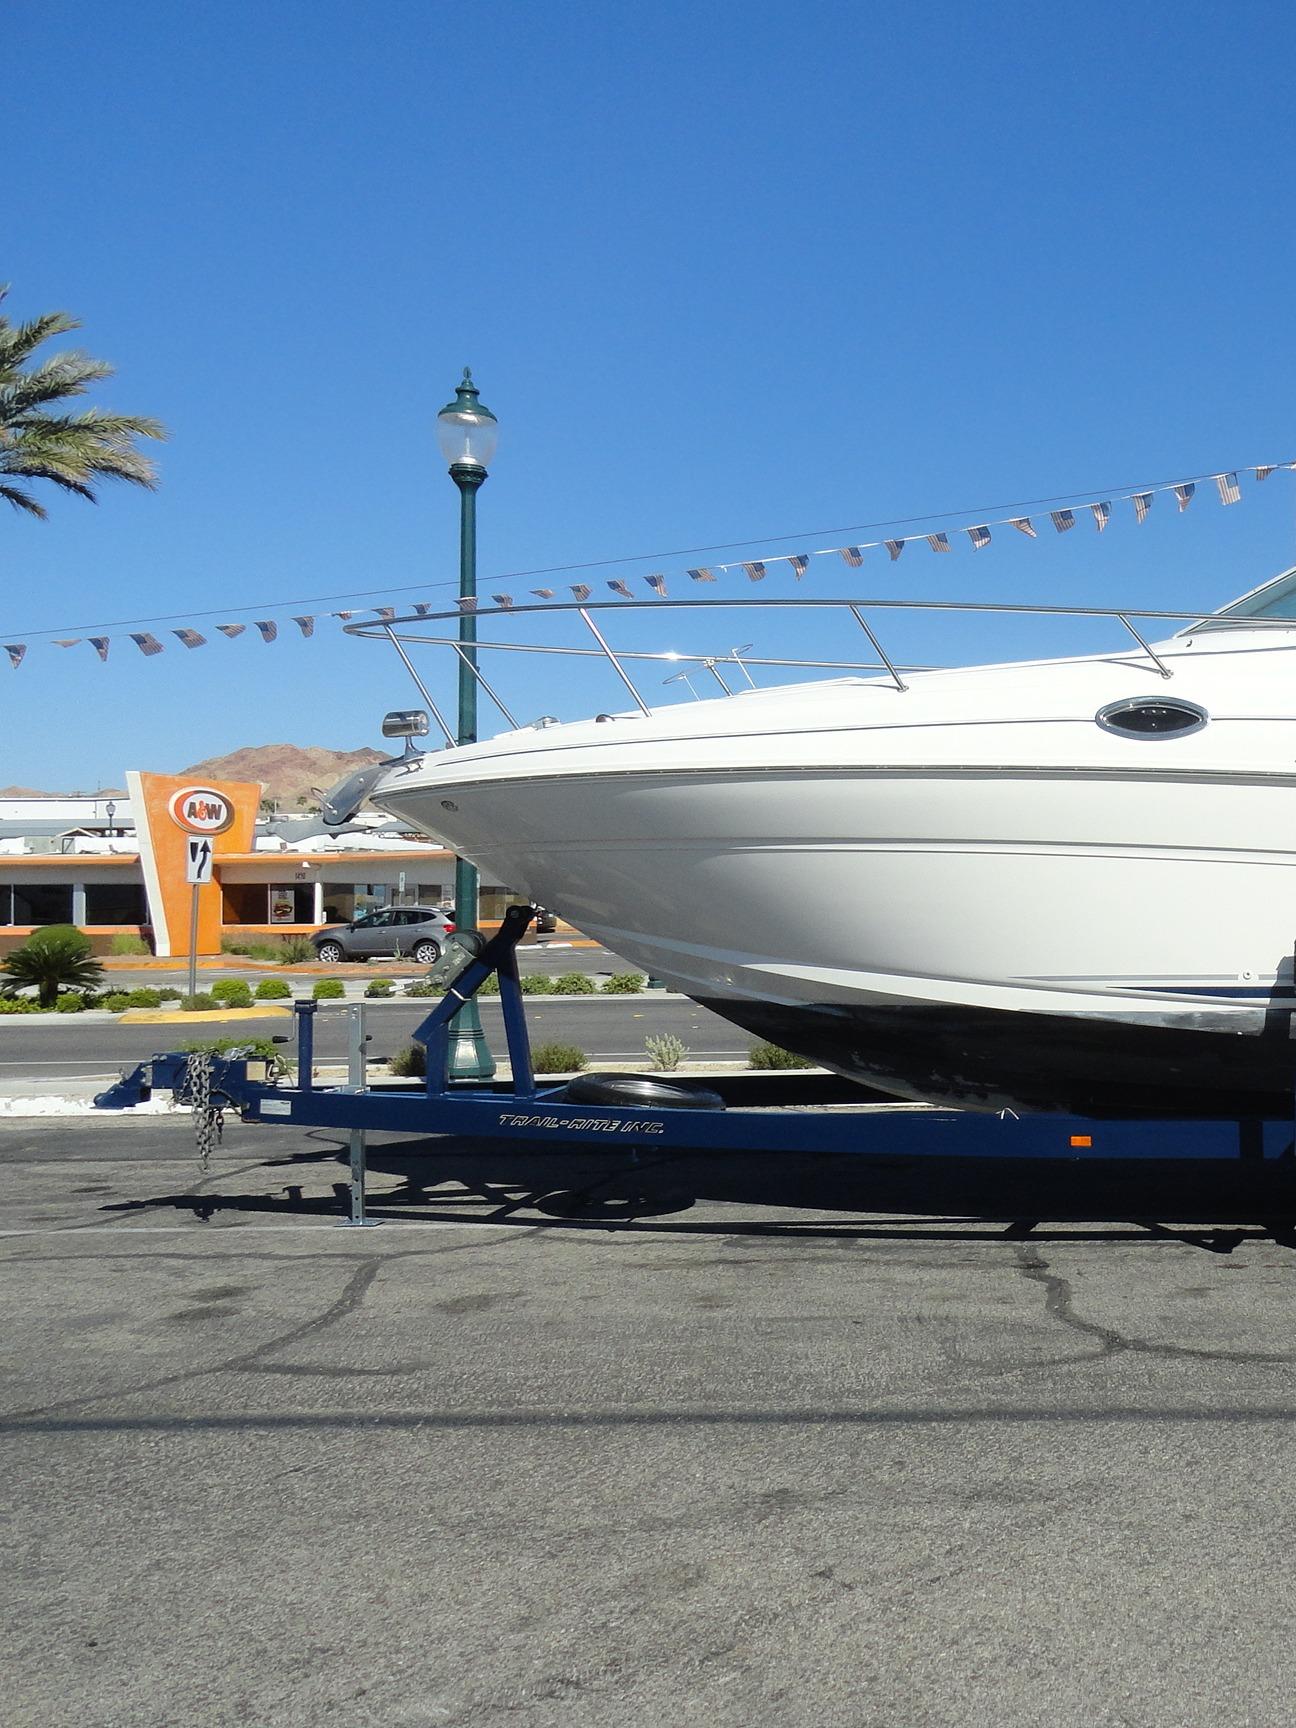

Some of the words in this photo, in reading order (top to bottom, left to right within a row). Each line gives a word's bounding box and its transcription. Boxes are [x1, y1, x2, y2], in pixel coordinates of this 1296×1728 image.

[187, 800, 223, 821] A&W
[499, 1114, 621, 1132] TRAIL-RITE
[621, 1121, 664, 1134] INC.
